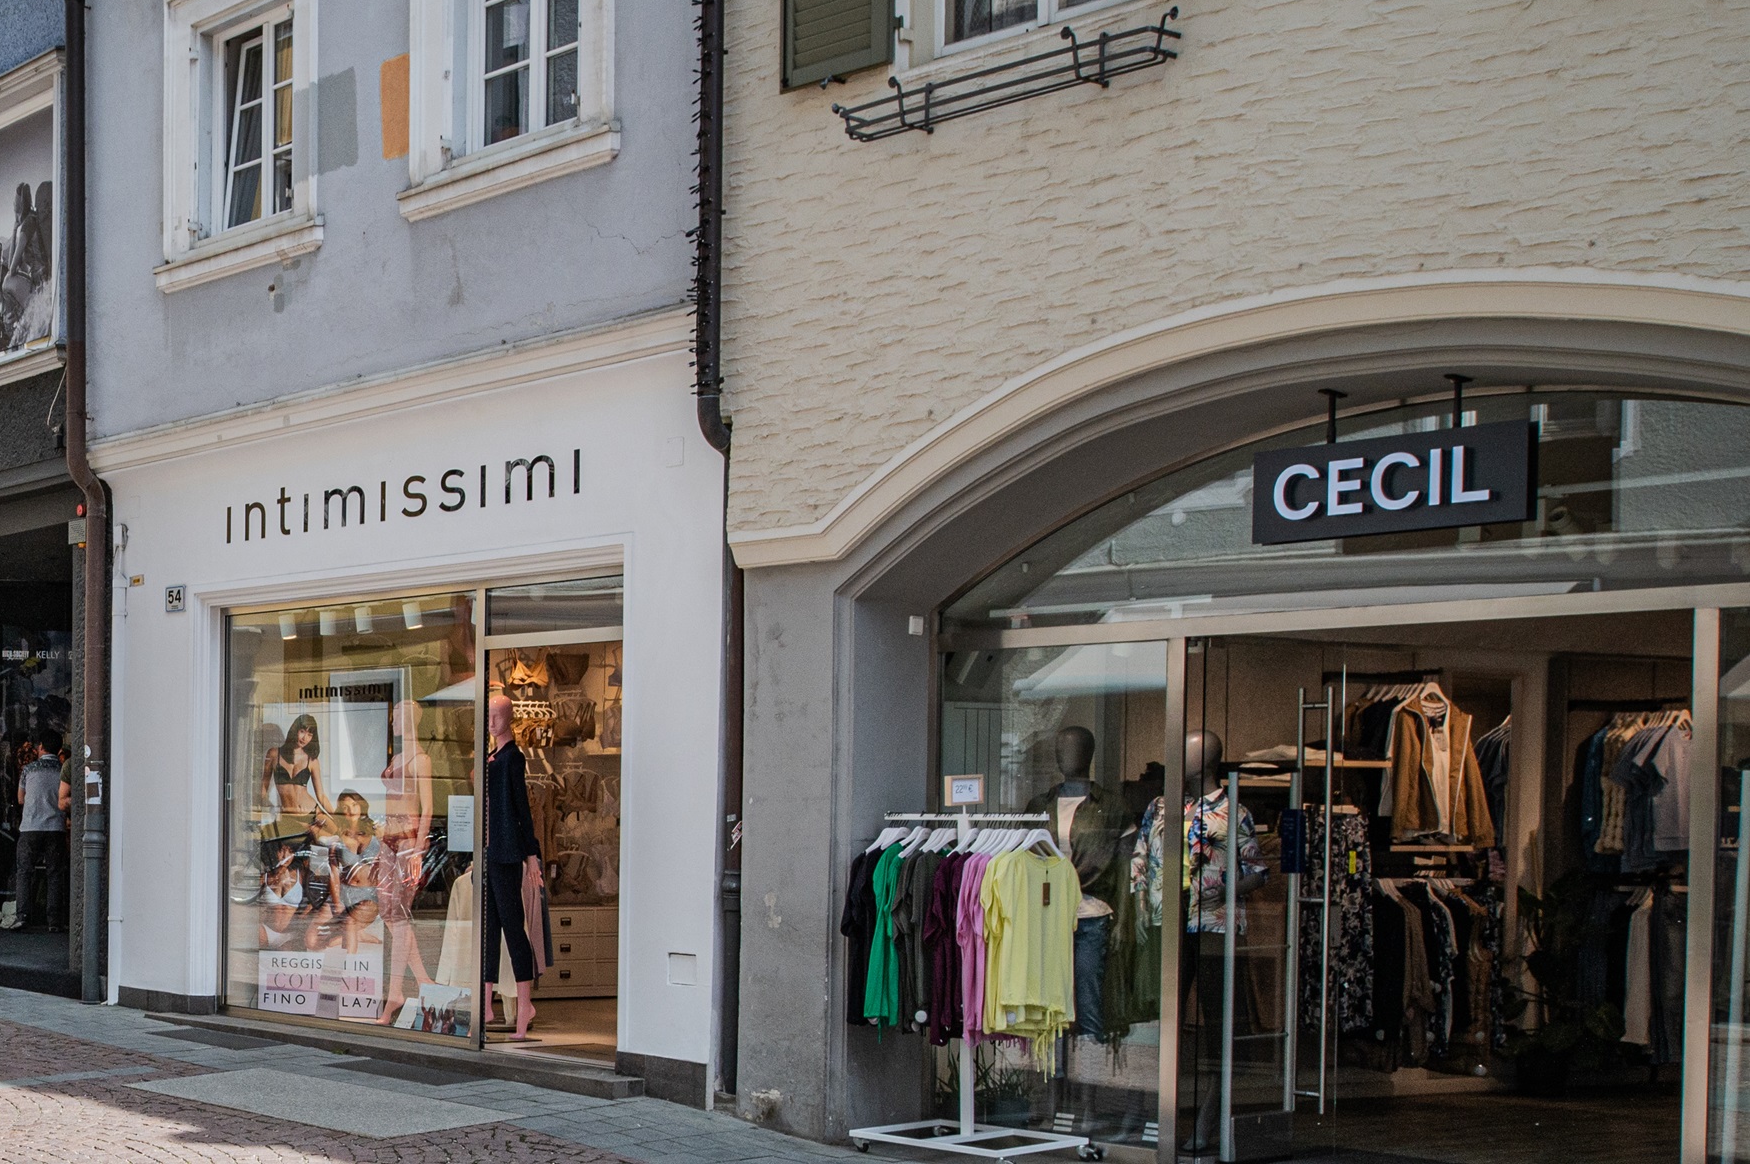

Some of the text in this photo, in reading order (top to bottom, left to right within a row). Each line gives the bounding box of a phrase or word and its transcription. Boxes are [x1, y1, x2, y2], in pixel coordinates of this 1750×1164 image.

[1273, 445, 1490, 521] CECIL
[226, 448, 580, 544] intimissimi
[167, 589, 182, 604] 54
[36, 650, 60, 659] KELLY
[353, 960, 370, 972] IN
[273, 972, 368, 993] COTNE
[263, 992, 306, 1005] FINO
